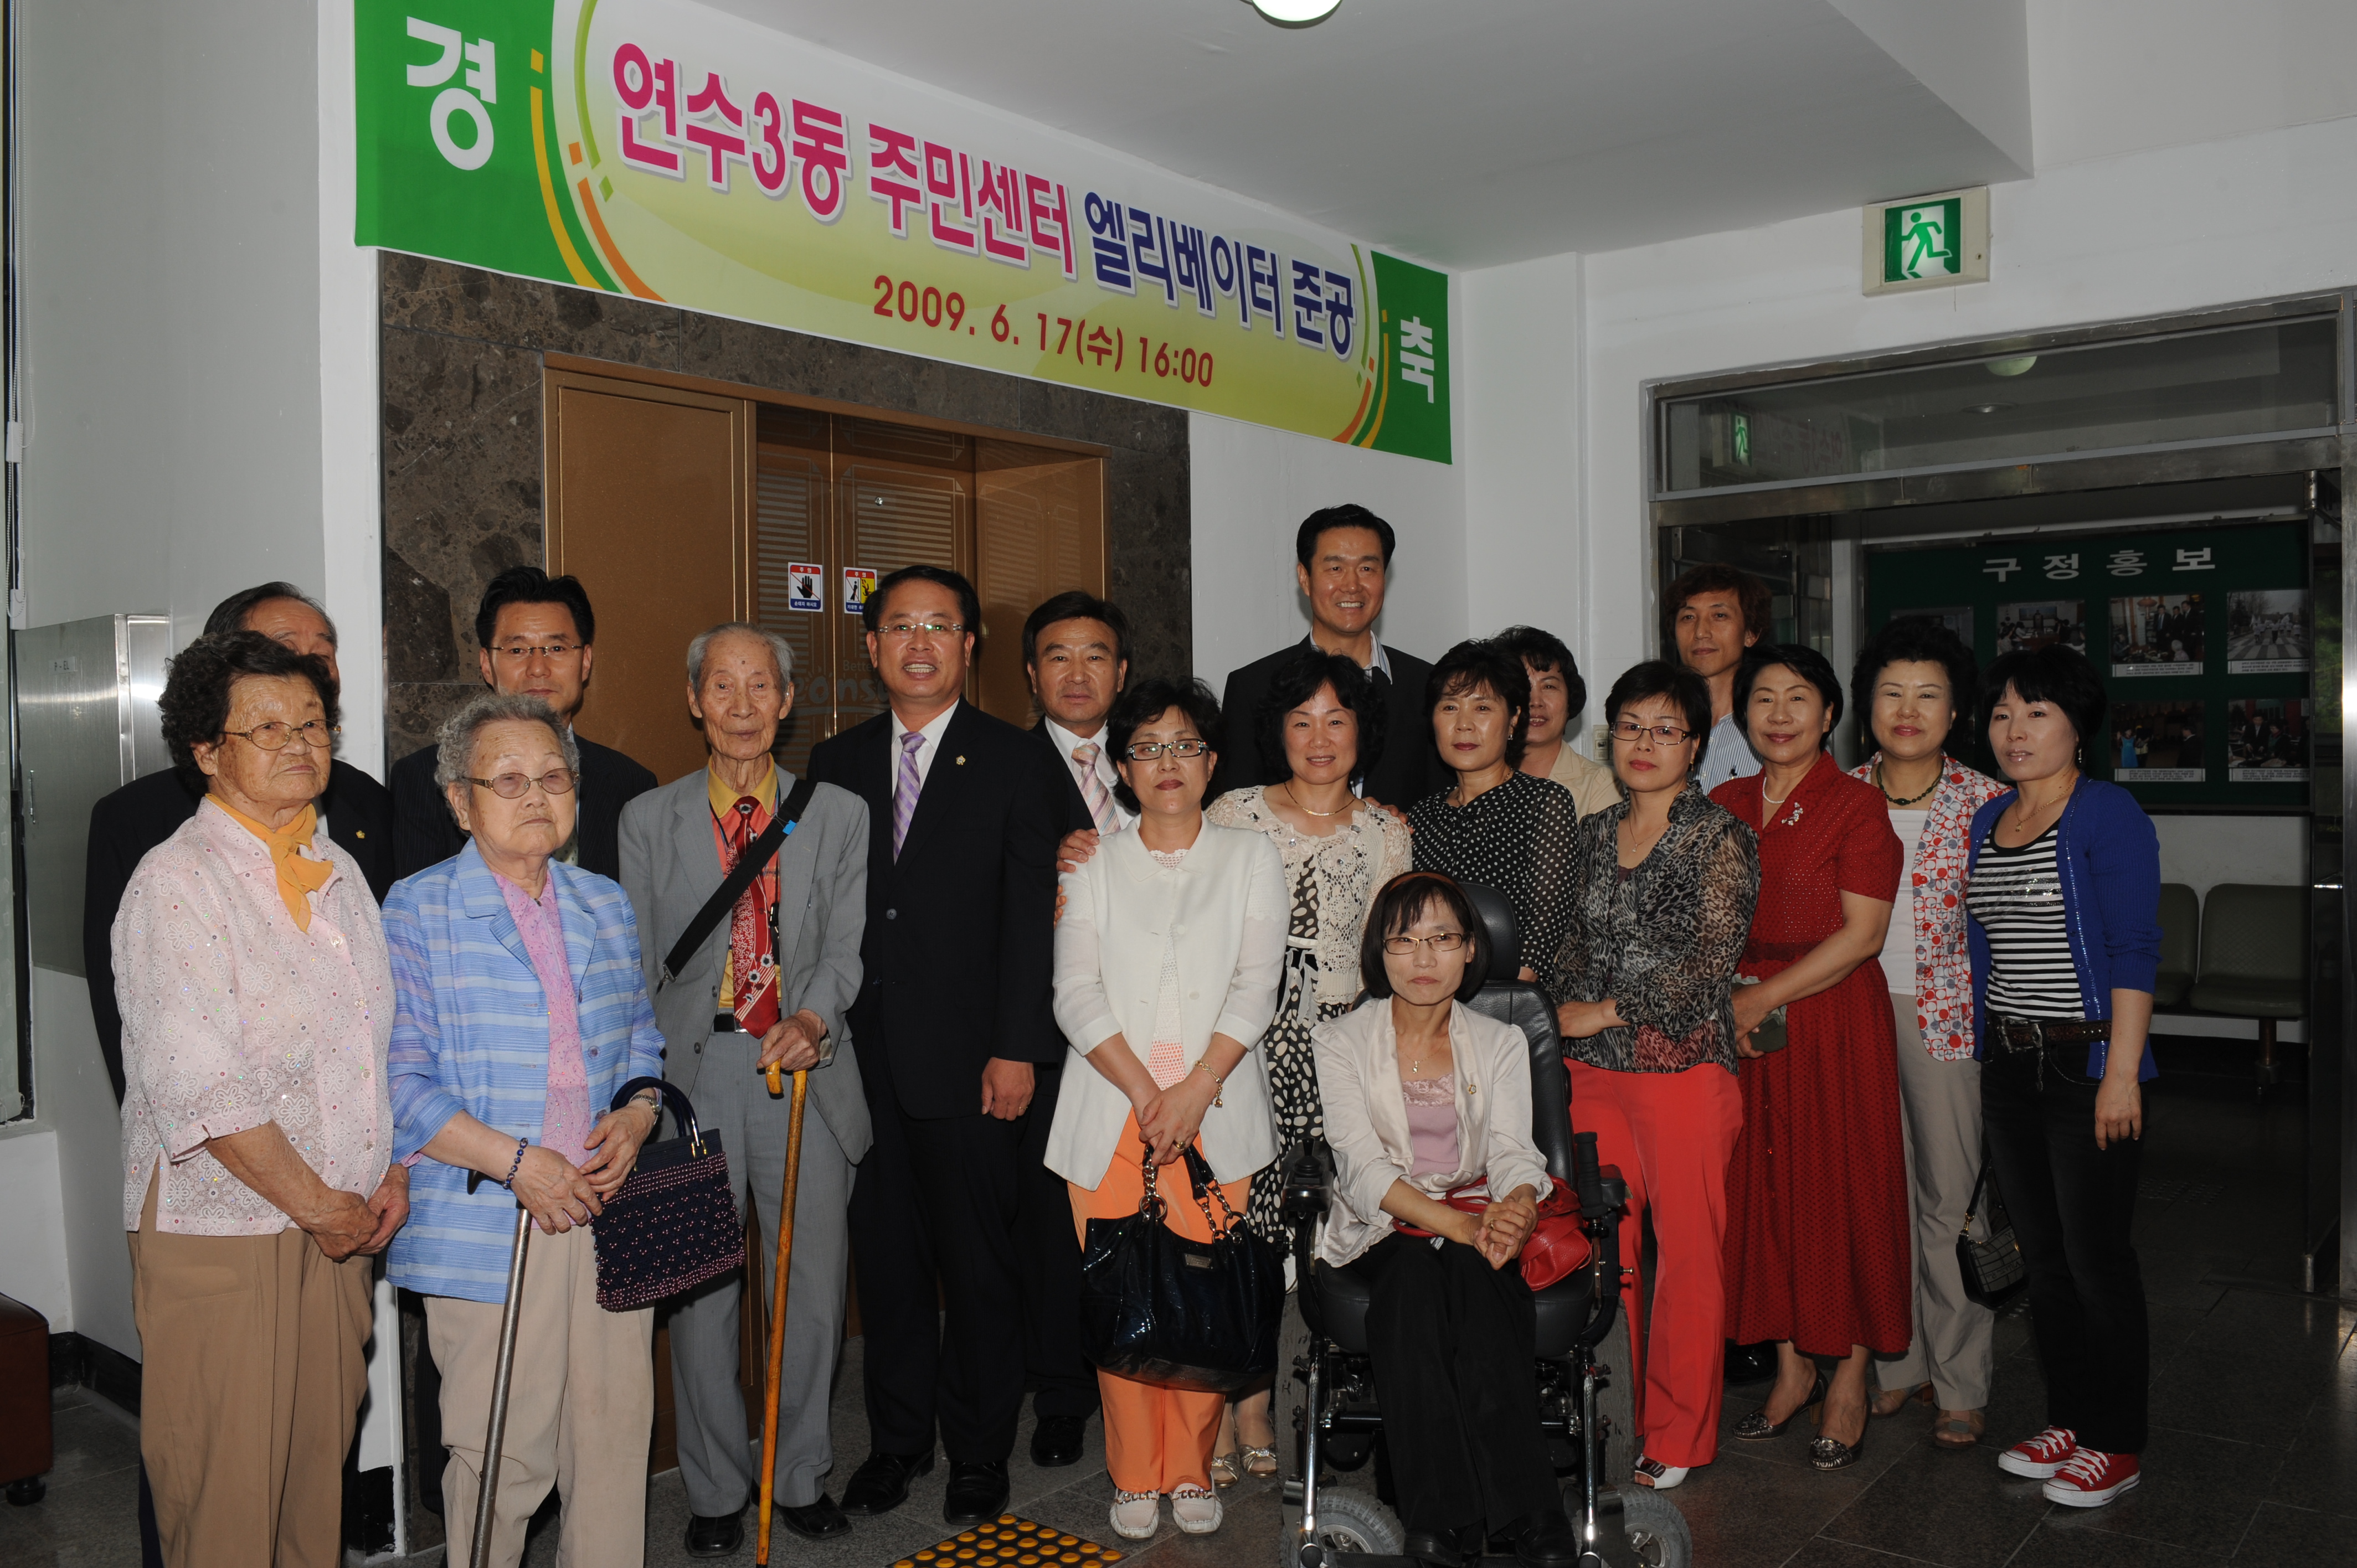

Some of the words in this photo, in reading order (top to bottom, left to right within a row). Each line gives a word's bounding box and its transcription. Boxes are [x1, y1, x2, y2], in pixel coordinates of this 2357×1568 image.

[406, 16, 497, 171] 경
[612, 42, 848, 216] 연수3동
[868, 122, 1073, 275] 주민센터
[1084, 191, 1283, 337] 엘리베이터
[1291, 259, 1355, 355] 준공
[873, 275, 975, 336] 2009.
[991, 303, 1019, 345] 6.
[1037, 312, 1124, 372] 17(수)
[1139, 336, 1213, 387] 16:00
[1399, 315, 1435, 404] 축
